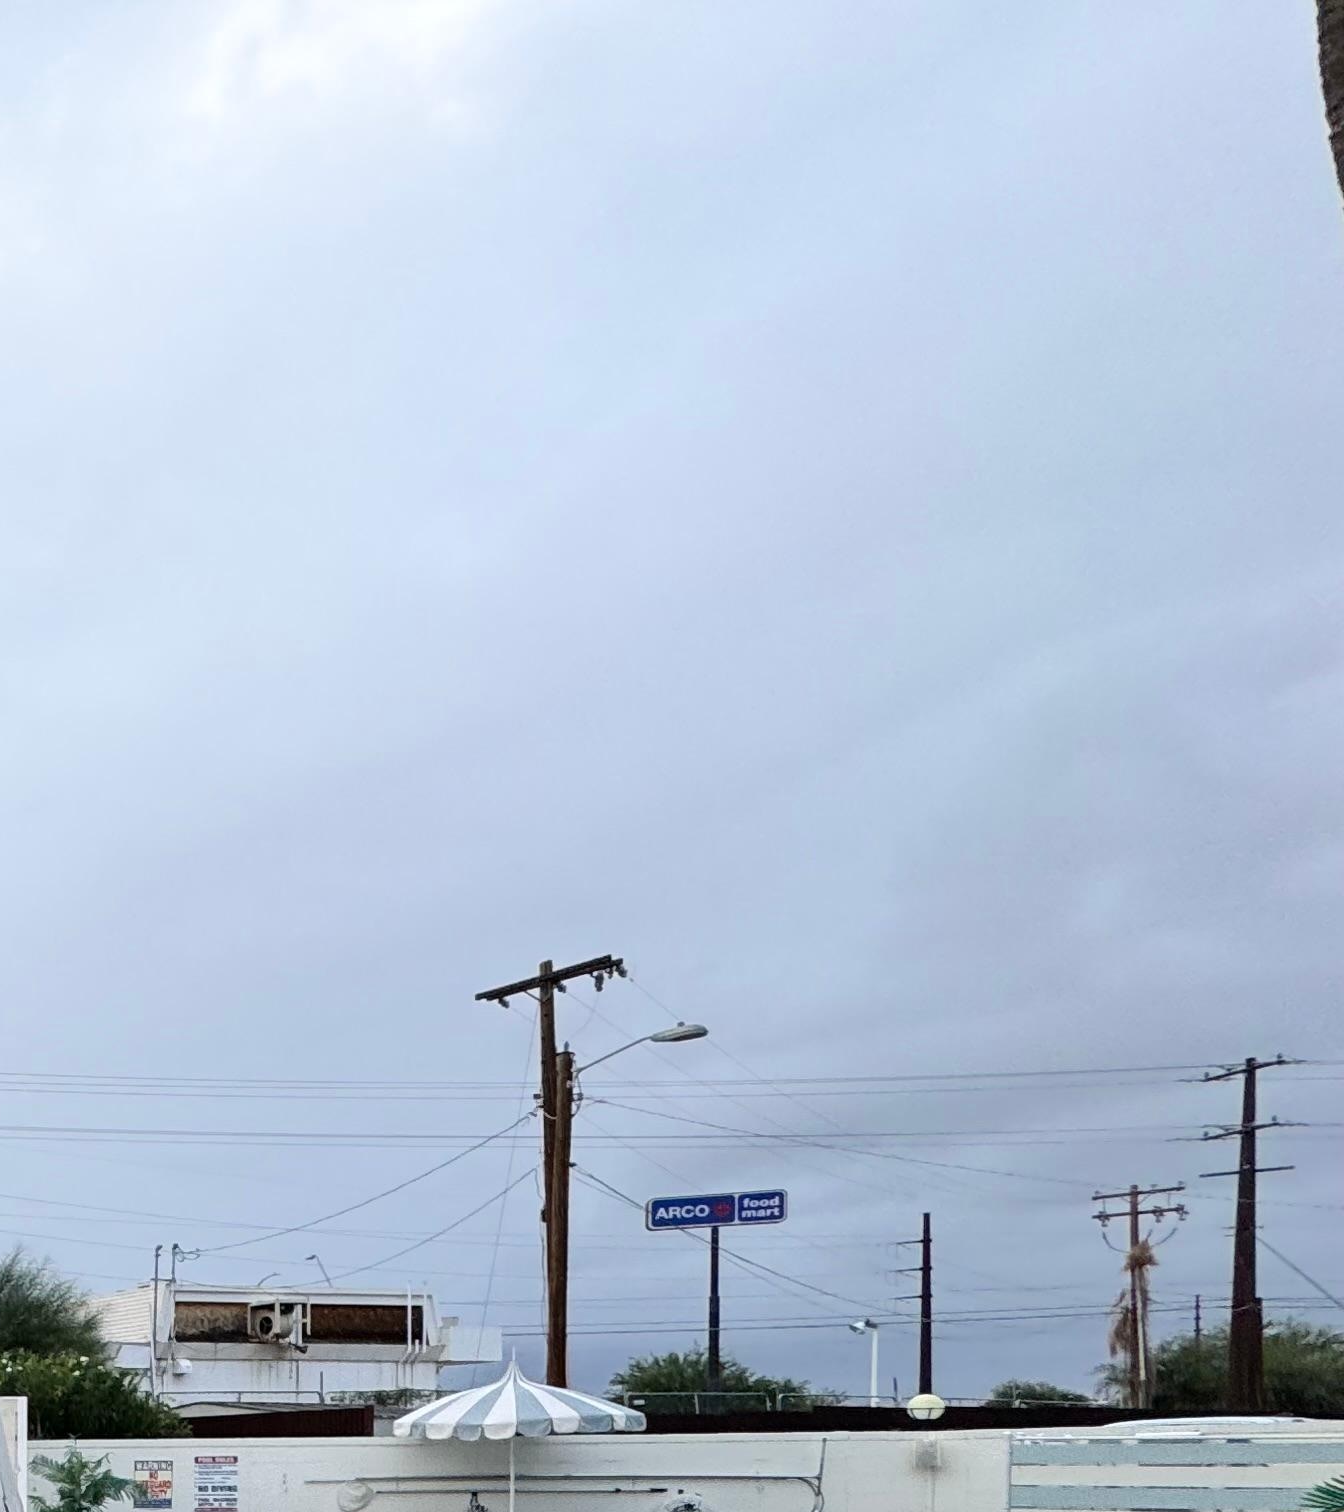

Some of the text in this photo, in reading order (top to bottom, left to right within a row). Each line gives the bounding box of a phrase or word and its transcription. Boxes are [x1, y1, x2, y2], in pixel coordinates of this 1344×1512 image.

[742, 1196, 780, 1208] food
[655, 1204, 710, 1221] ARCO
[741, 1207, 780, 1218] mart
[135, 1461, 172, 1471] WARNING
